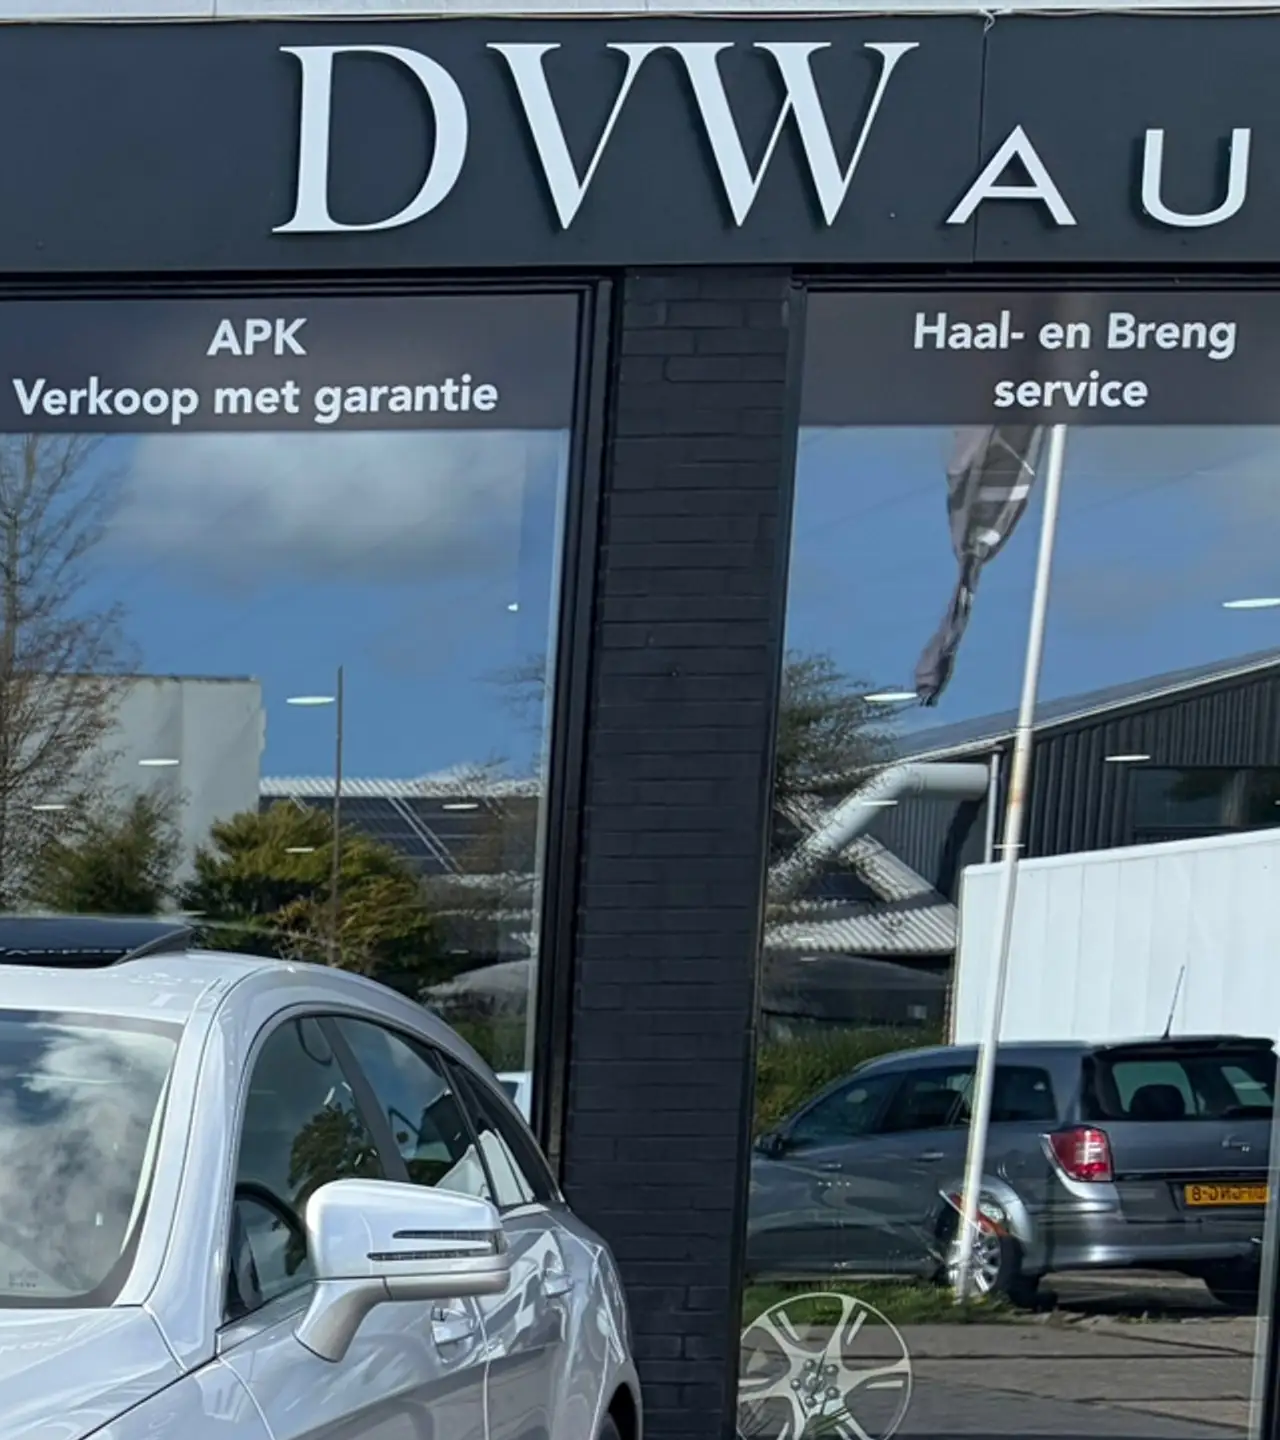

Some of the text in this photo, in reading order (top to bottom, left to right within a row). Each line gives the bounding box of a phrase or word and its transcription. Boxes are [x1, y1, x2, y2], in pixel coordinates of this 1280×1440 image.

[272, 42, 1251, 233] DVW AU
[206, 318, 308, 356] APK
[914, 310, 1237, 360] Haal- en Breng
[12, 373, 499, 425] Verkoop met garantie
[993, 369, 1149, 408] service
